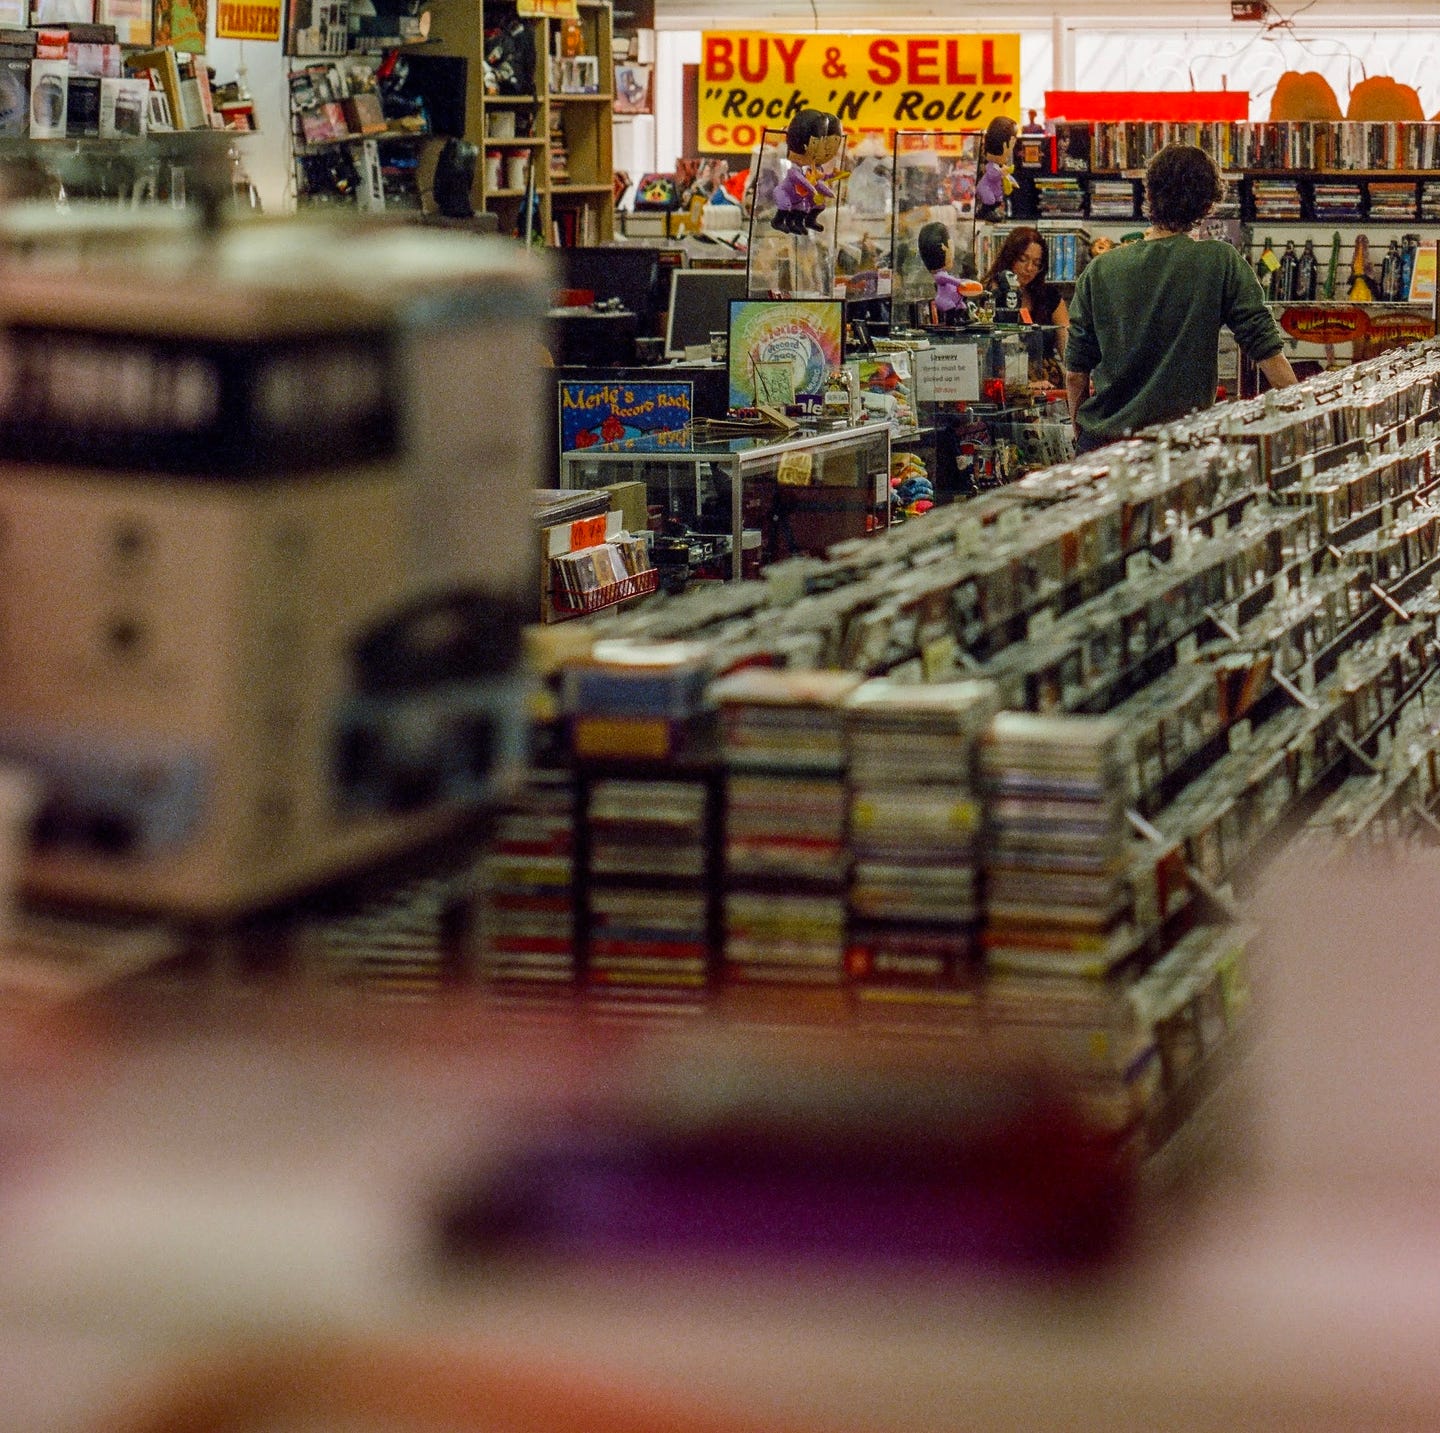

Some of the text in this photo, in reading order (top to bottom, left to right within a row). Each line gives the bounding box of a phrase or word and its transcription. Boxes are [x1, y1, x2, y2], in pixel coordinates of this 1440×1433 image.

[705, 38, 1013, 85] BUY & SELL
[657, 393, 691, 412] Rack
[799, 399, 823, 416] ale
